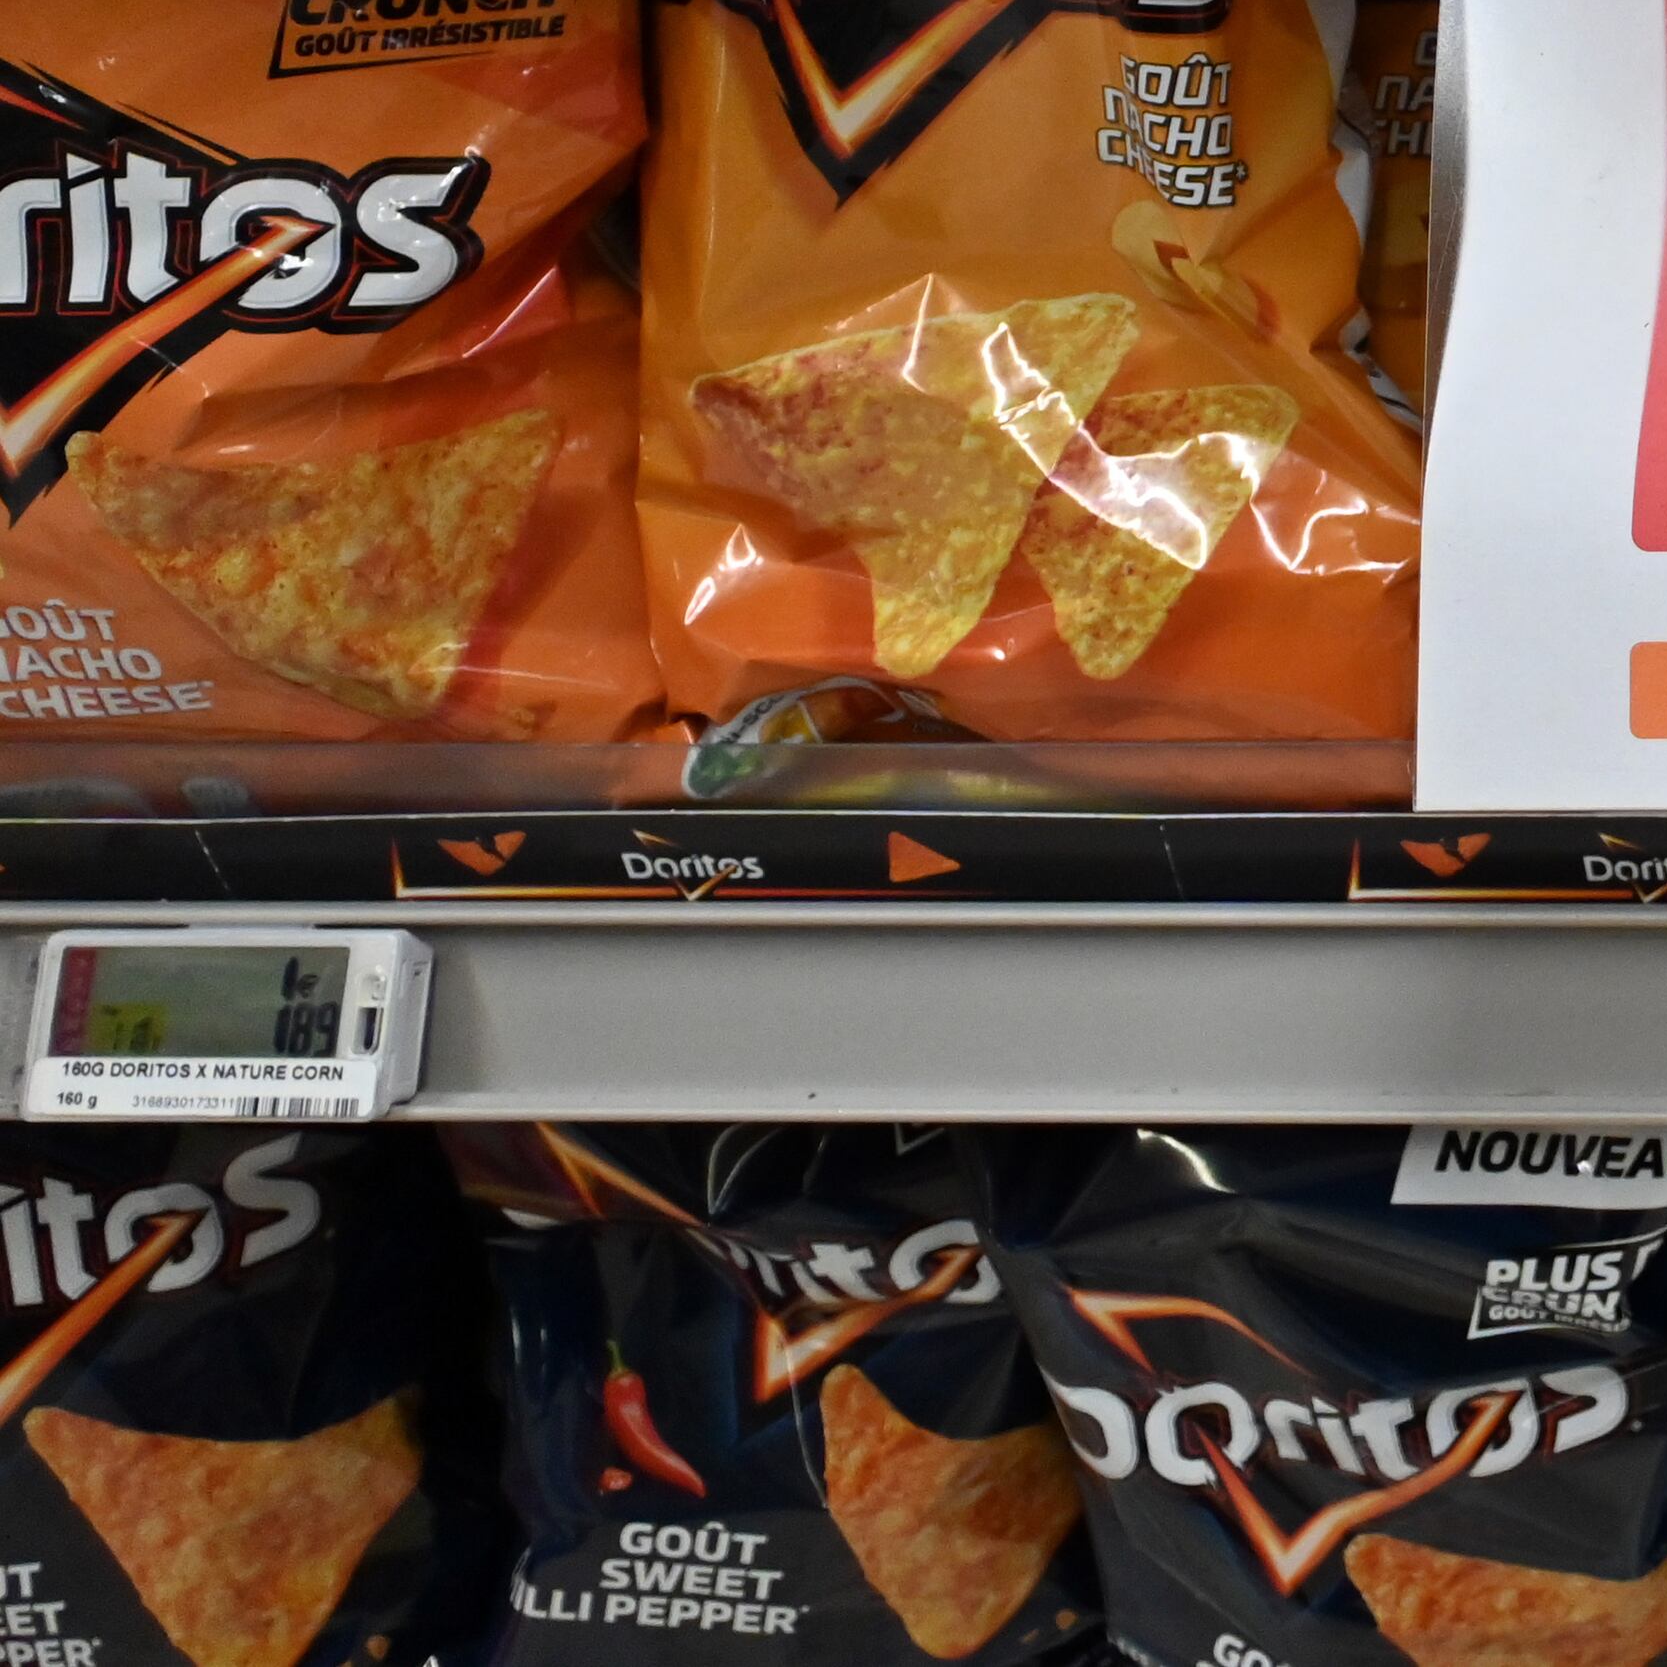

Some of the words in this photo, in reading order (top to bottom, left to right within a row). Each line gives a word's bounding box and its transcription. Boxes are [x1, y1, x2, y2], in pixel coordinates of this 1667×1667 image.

[294, 25, 373, 57] GOÛT
[379, 13, 565, 51] IRRÉSISTIBLE
[1120, 53, 1233, 107] GOÛT
[0, 150, 459, 308] ritos
[0, 600, 115, 644] OÛT
[621, 851, 765, 882] Doritos
[62, 1061, 105, 1078] 160G
[109, 1062, 191, 1079] DORITOS
[195, 1063, 208, 1080] X
[212, 1063, 287, 1081] NATURE
[291, 1064, 345, 1081] CORN
[56, 1091, 84, 1106] 160
[87, 1094, 99, 1110] g
[1486, 1249, 1625, 1293] PLUS
[619, 1522, 767, 1566] GOÛT
[600, 1559, 784, 1602] SWEET
